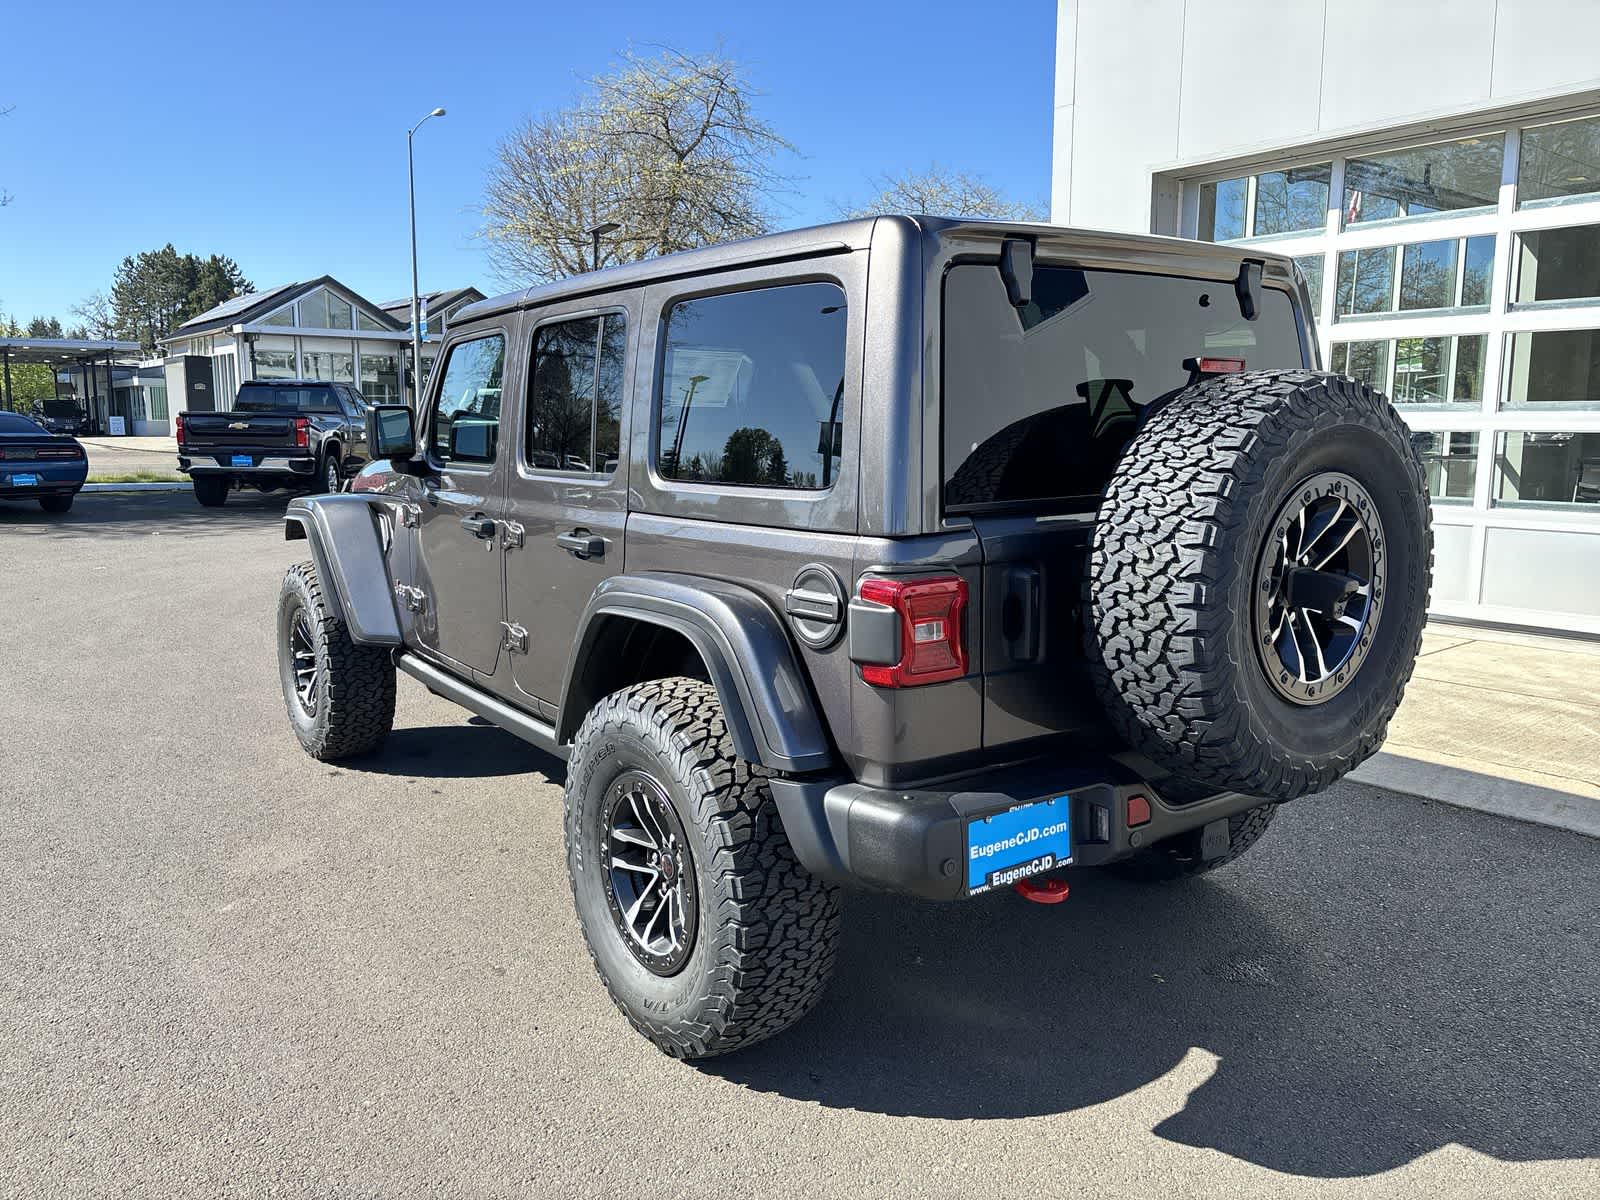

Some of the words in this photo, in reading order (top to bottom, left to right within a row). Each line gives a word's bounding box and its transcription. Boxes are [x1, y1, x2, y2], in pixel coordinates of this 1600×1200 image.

[970, 822, 1067, 859] EugeneCJD.com
[969, 885, 991, 896] www.
[992, 856, 1053, 886] EugeneCJD
[1055, 857, 1073, 868] .com
